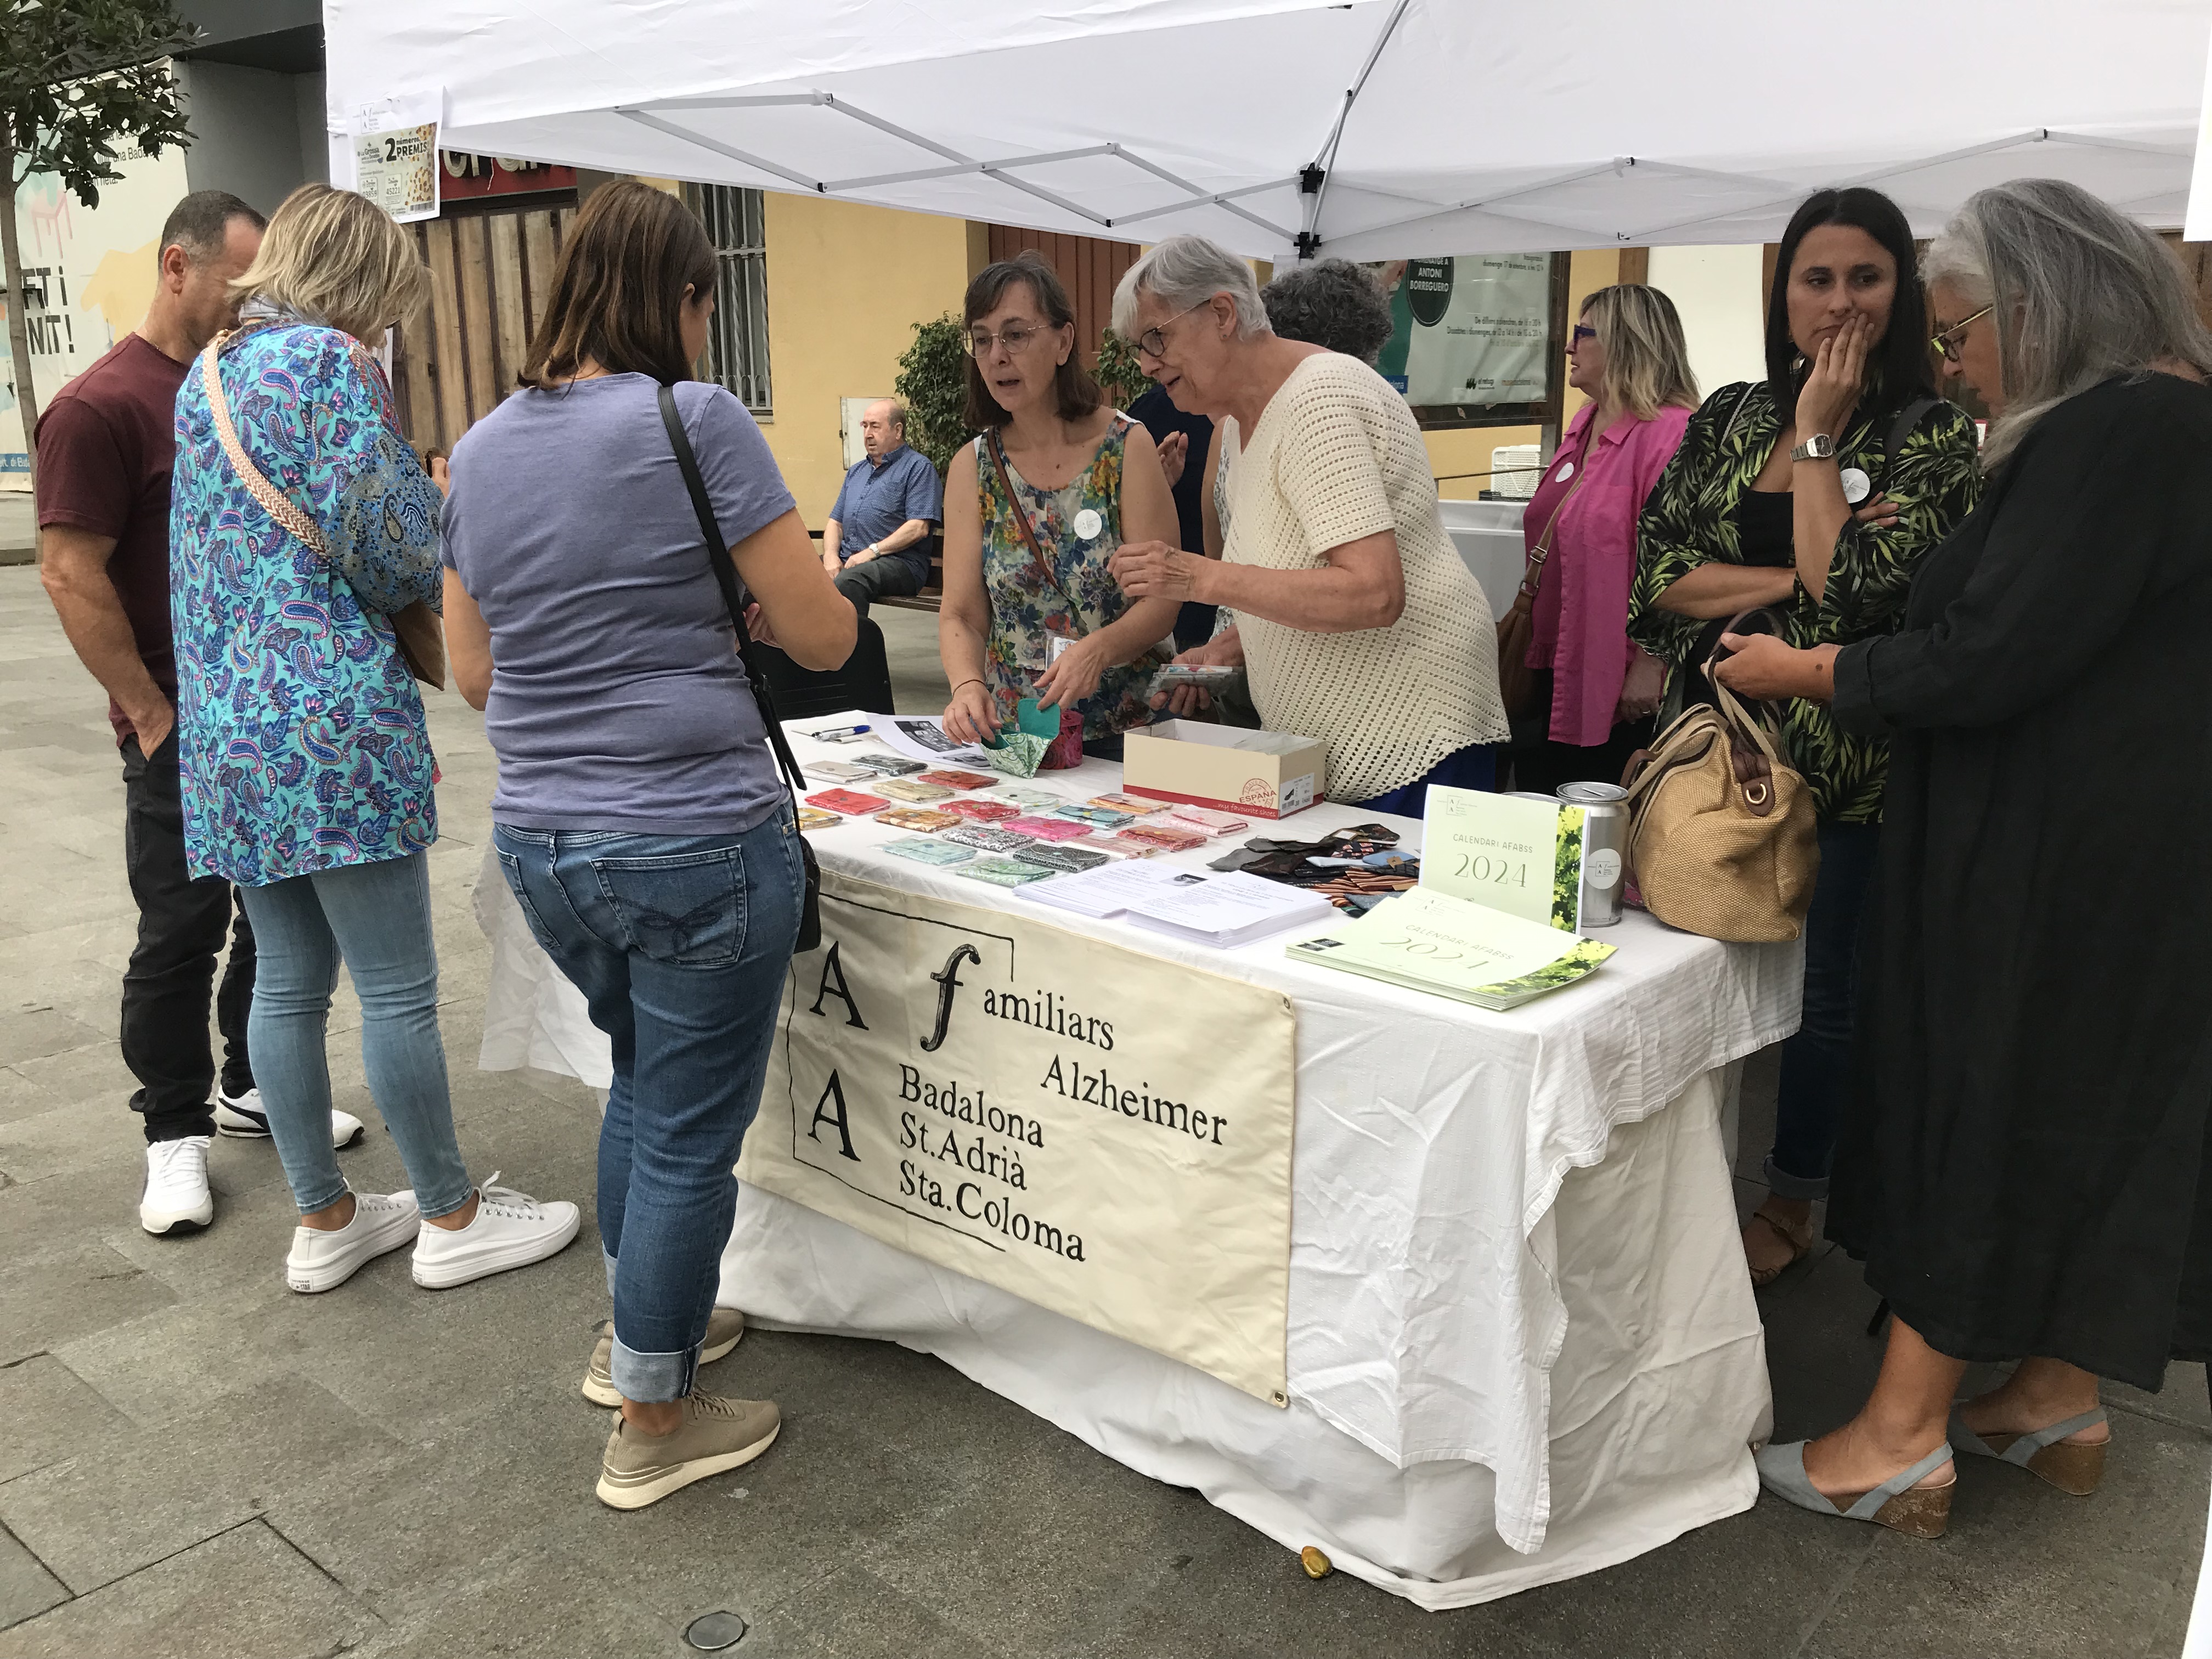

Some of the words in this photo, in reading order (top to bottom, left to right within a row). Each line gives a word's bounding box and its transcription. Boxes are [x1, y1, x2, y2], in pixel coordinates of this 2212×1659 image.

[385, 138, 397, 162] 2
[1410, 280, 1449, 292] BORREGUERO
[1418, 268, 1442, 278] ANTONI
[1231, 803, 1259, 815] favourite
[1259, 809, 1277, 817] shoes
[1239, 790, 1277, 803] ESPAÑA
[1453, 833, 1499, 848] CALENDARI
[1502, 842, 1533, 853] AFABSS
[1454, 853, 1526, 888] 2024
[1405, 924, 1469, 946] CALENDARI
[1470, 944, 1515, 960] AFABSS
[809, 940, 869, 1031] A
[898, 1063, 1045, 1148] Badalona
[1040, 1054, 1228, 1146] Alzheimer
[808, 1068, 861, 1162] A
